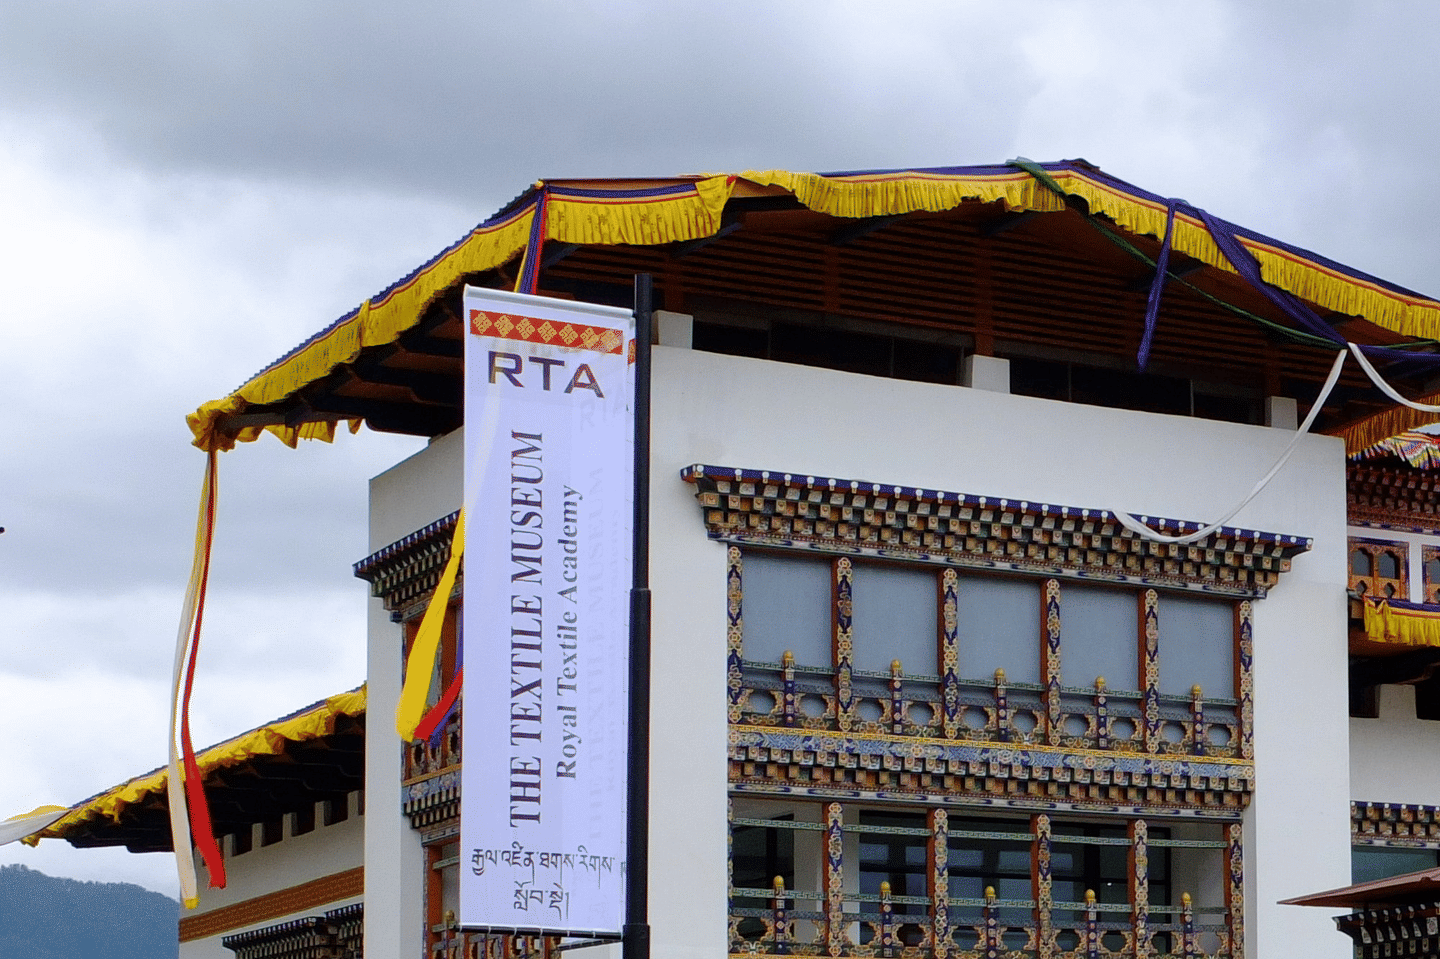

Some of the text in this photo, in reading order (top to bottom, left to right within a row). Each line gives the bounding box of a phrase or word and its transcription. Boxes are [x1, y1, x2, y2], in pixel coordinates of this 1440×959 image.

[488, 350, 605, 398] RTA
[509, 429, 544, 828] THE TEXTILE MUSEUM
[556, 484, 584, 780] Royal Textile Academy
